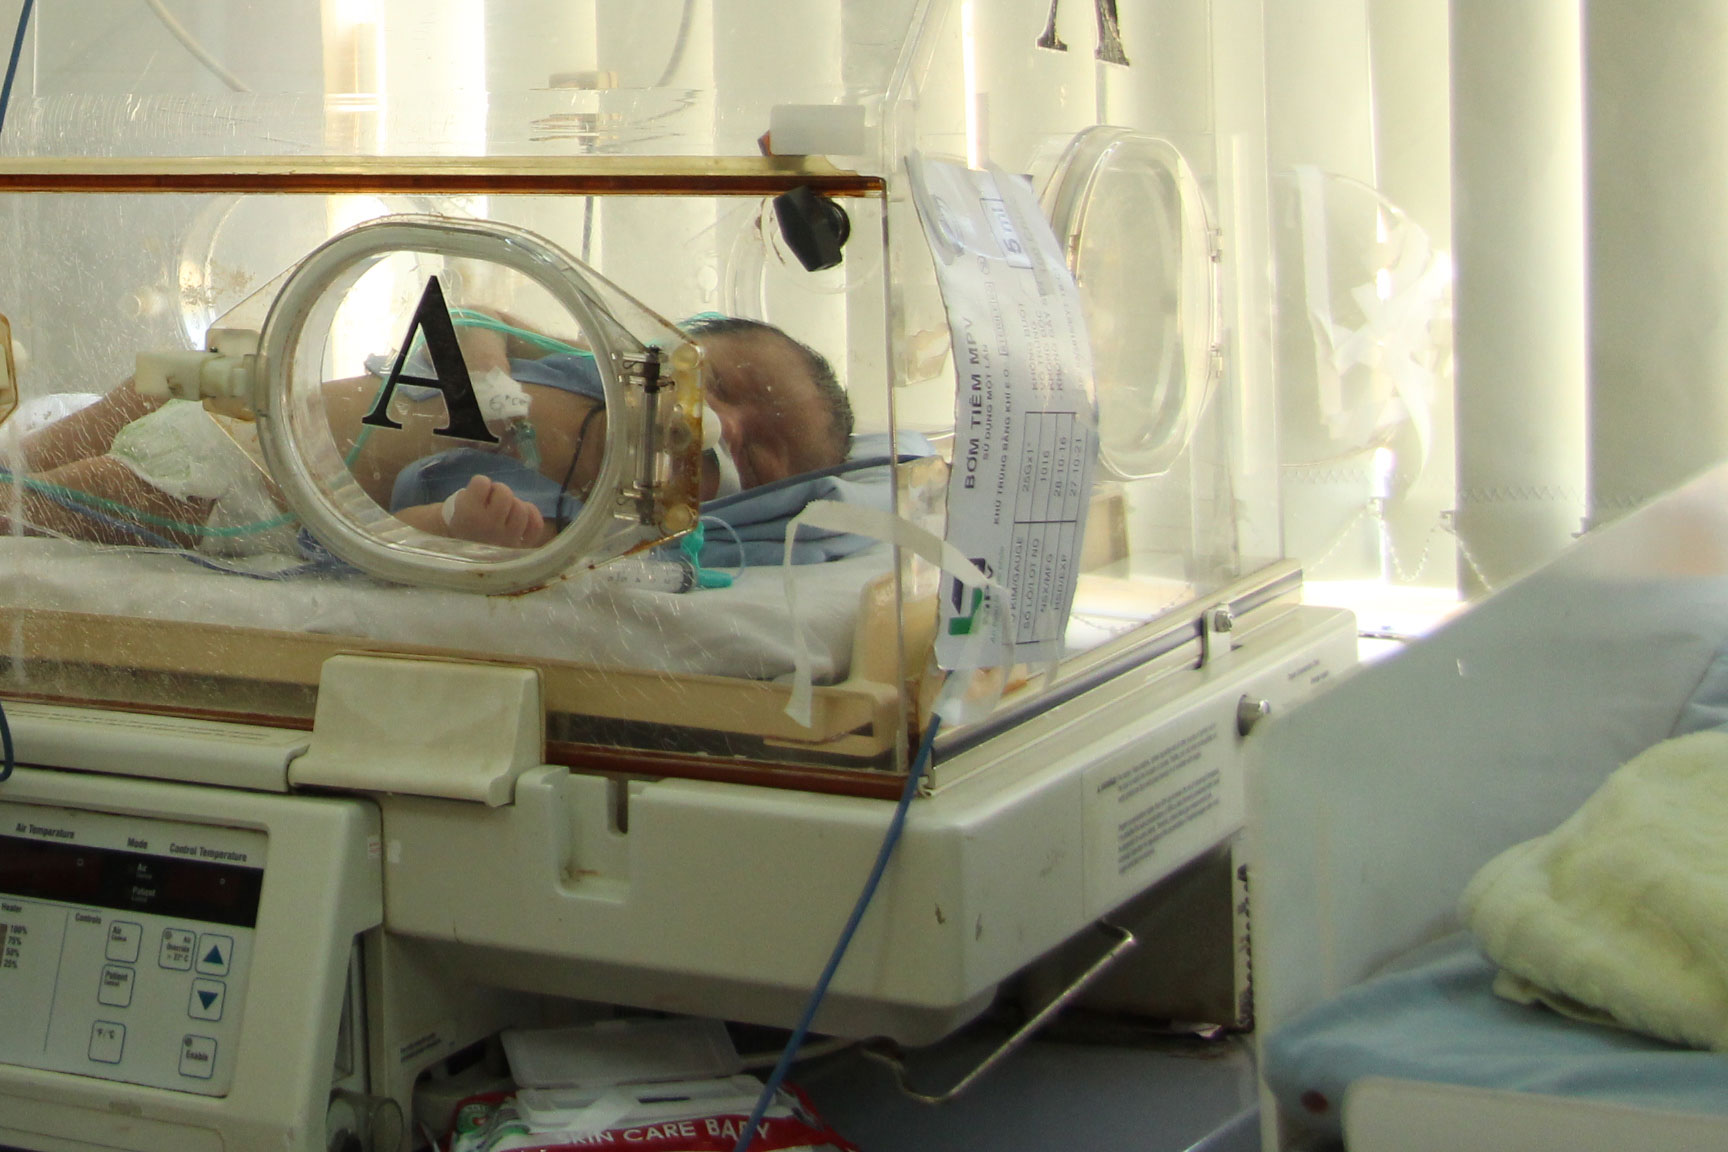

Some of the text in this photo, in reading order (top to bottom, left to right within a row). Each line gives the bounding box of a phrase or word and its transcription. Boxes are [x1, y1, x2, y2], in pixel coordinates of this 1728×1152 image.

[991, 206, 1022, 254] 5 ml
[362, 275, 500, 444] A
[962, 316, 982, 490] BƠM TIÊM MPV
[15, 823, 75, 840] Air Temperature
[127, 836, 148, 849] Mode
[169, 842, 247, 863] Control Temperature
[75, 912, 102, 925] Controls
[112, 925, 122, 935] Air
[104, 970, 129, 981] Patient
[185, 1049, 209, 1062] Enable
[622, 1120, 697, 1142] CARE
